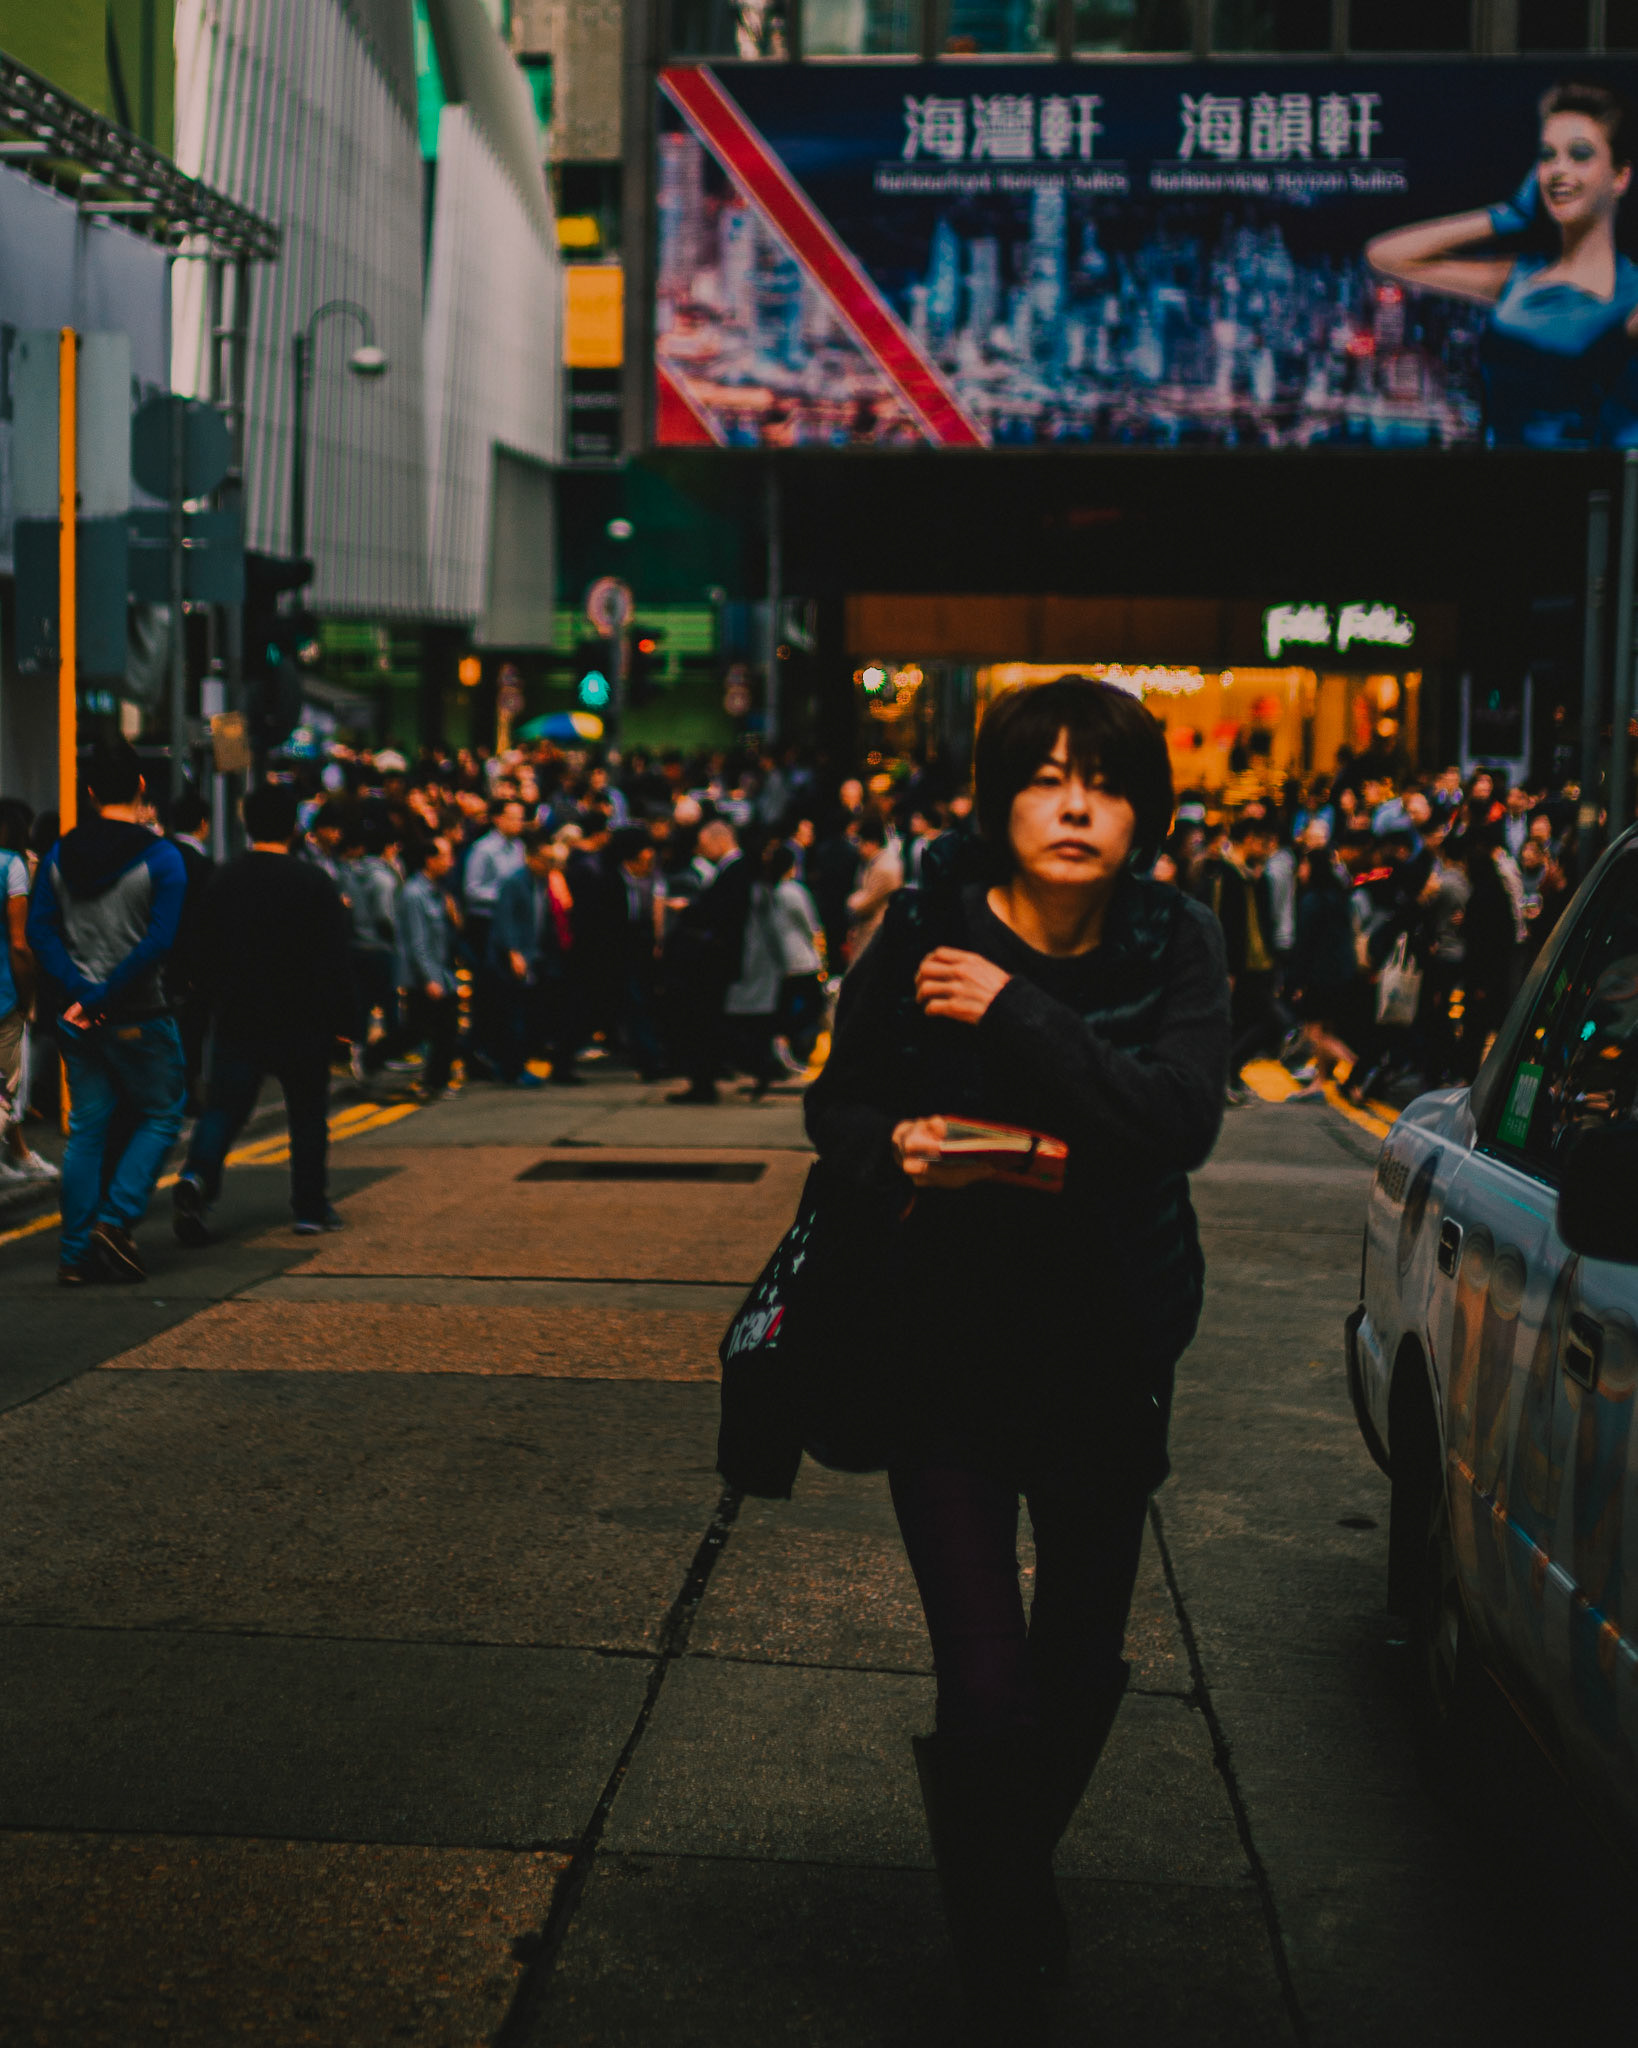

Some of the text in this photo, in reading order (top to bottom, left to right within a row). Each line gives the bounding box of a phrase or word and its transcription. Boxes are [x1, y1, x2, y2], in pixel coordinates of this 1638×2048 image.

[902, 94, 1104, 161] 海灣軒
[1178, 92, 1384, 161] 海韻軒
[1071, 170, 1129, 192] Suites
[1350, 169, 1407, 192] Suites
